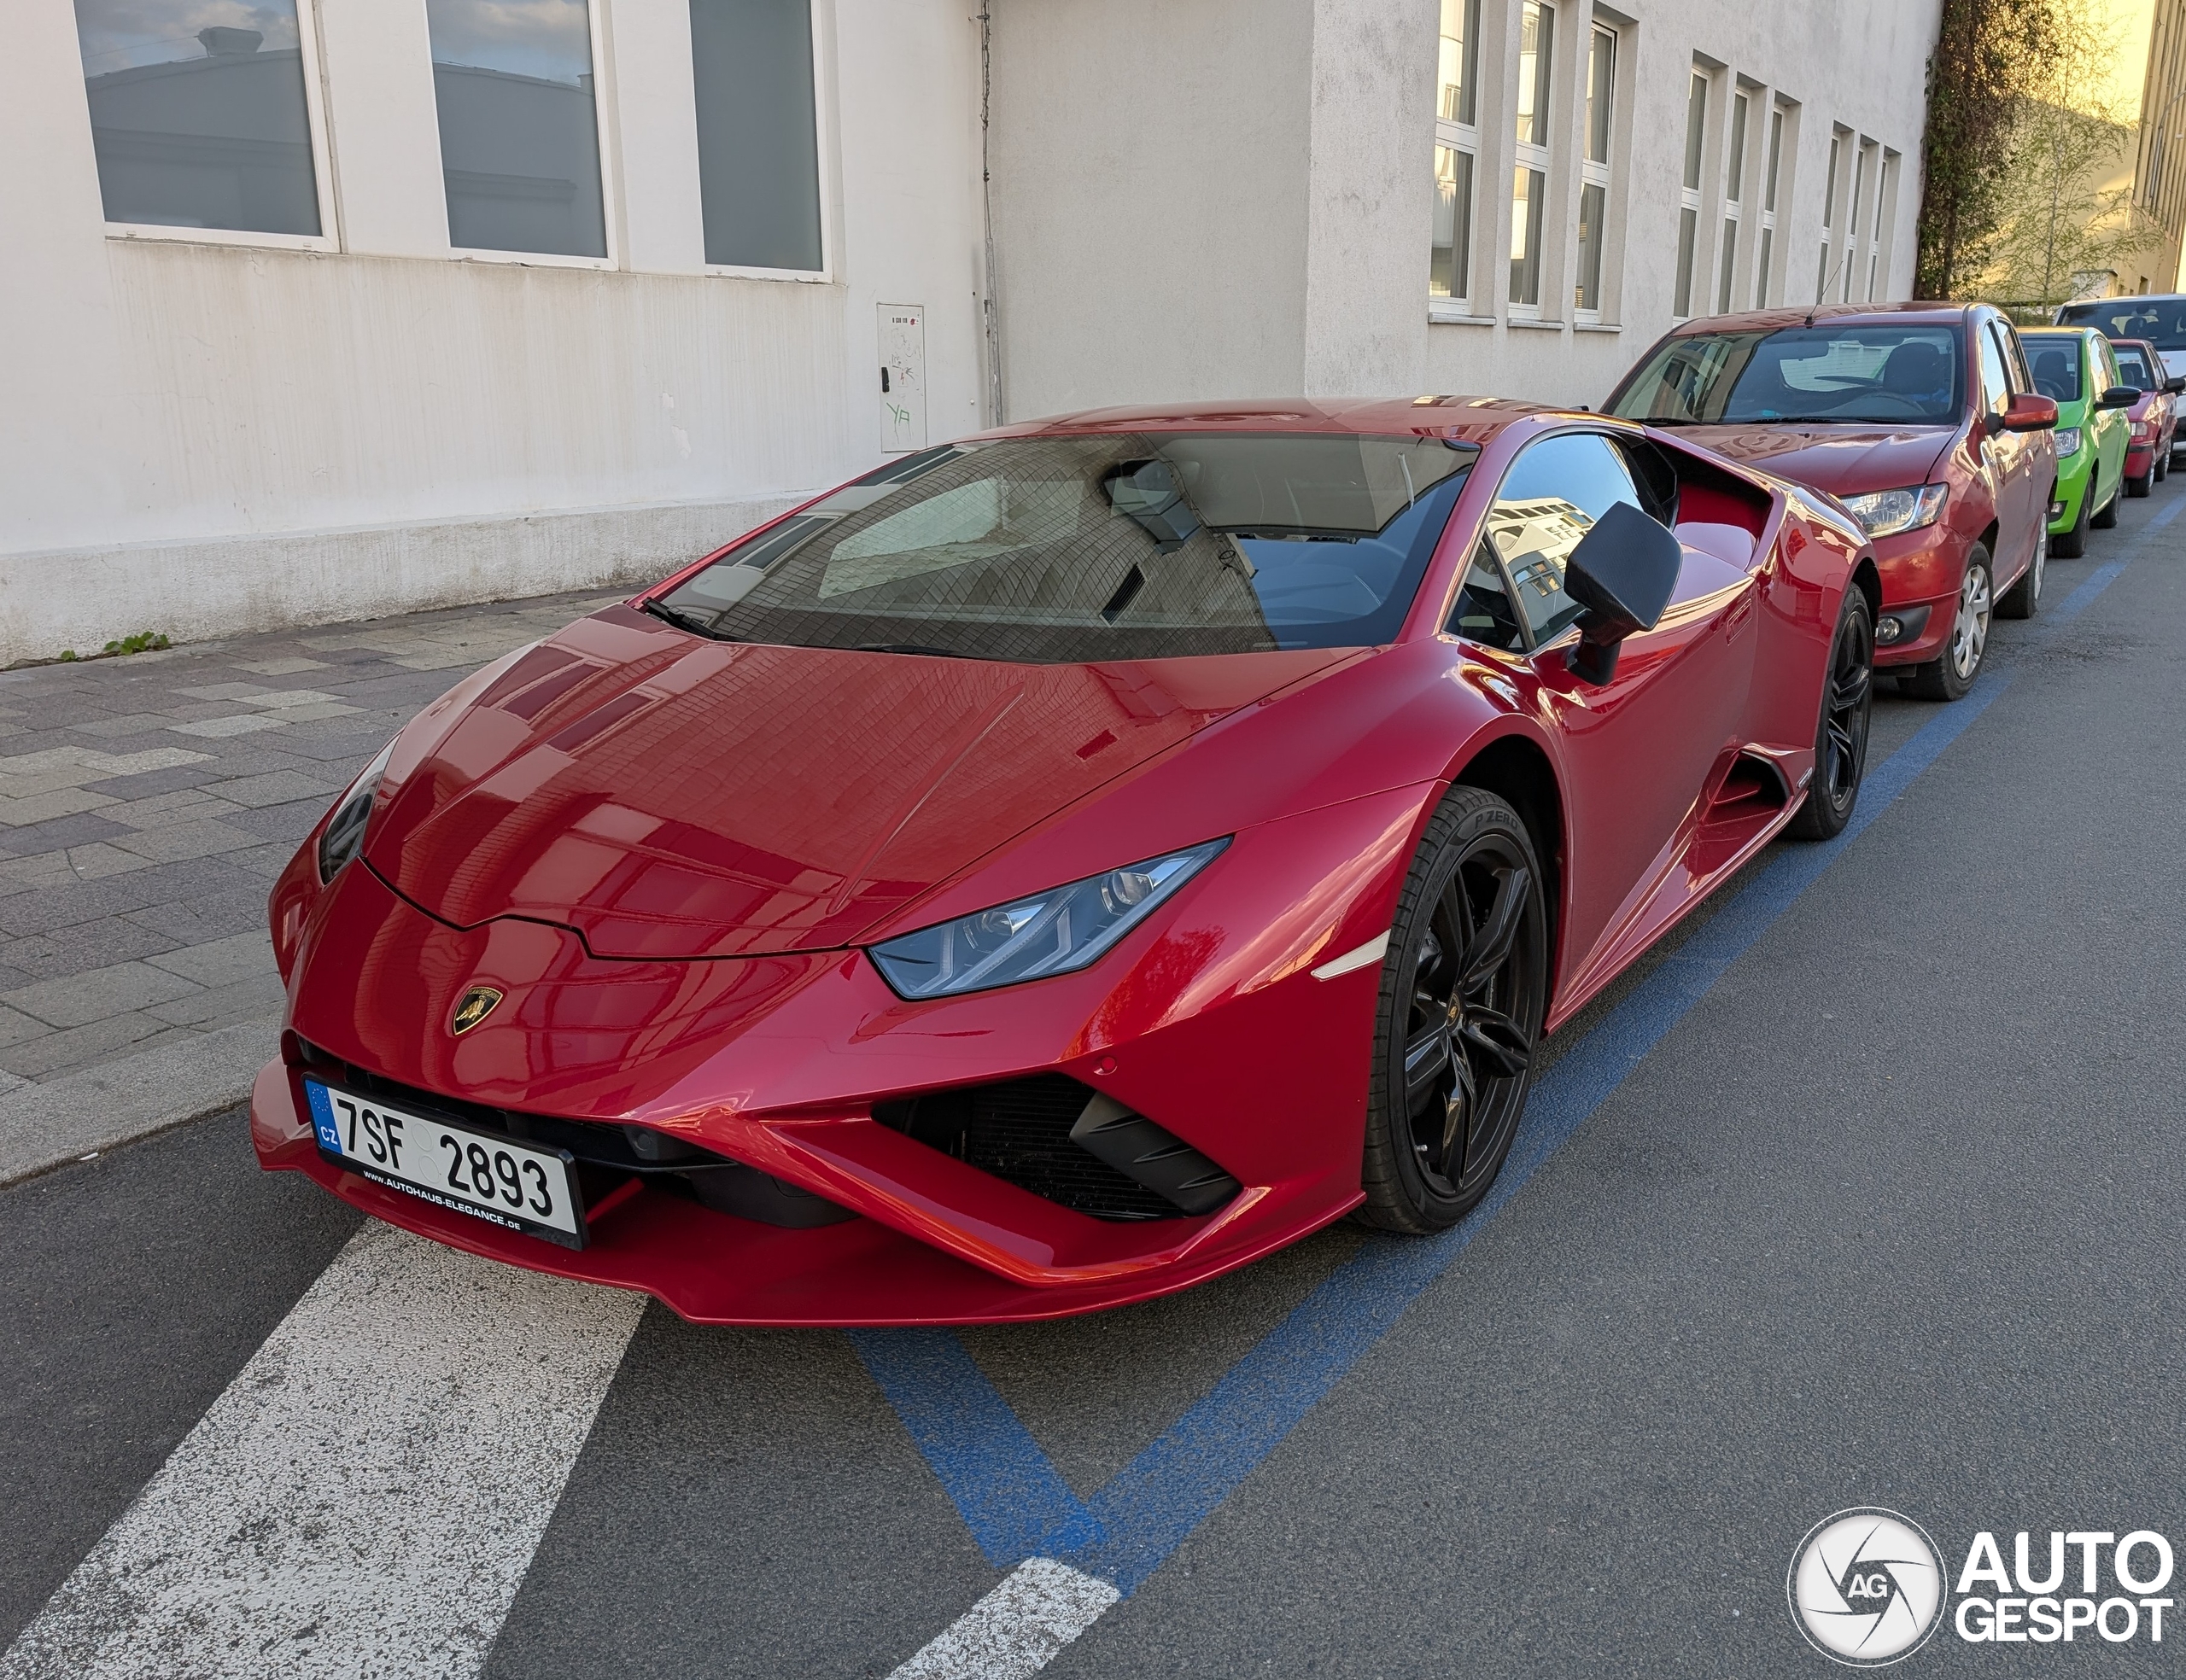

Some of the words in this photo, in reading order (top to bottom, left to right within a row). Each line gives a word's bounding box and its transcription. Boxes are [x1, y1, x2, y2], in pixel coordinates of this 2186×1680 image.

[1475, 814, 1483, 829] P
[1486, 810, 1518, 831] ZERO
[319, 1125, 338, 1145] CZ
[336, 1098, 404, 1170] 7SF
[440, 1134, 553, 1217] 2893
